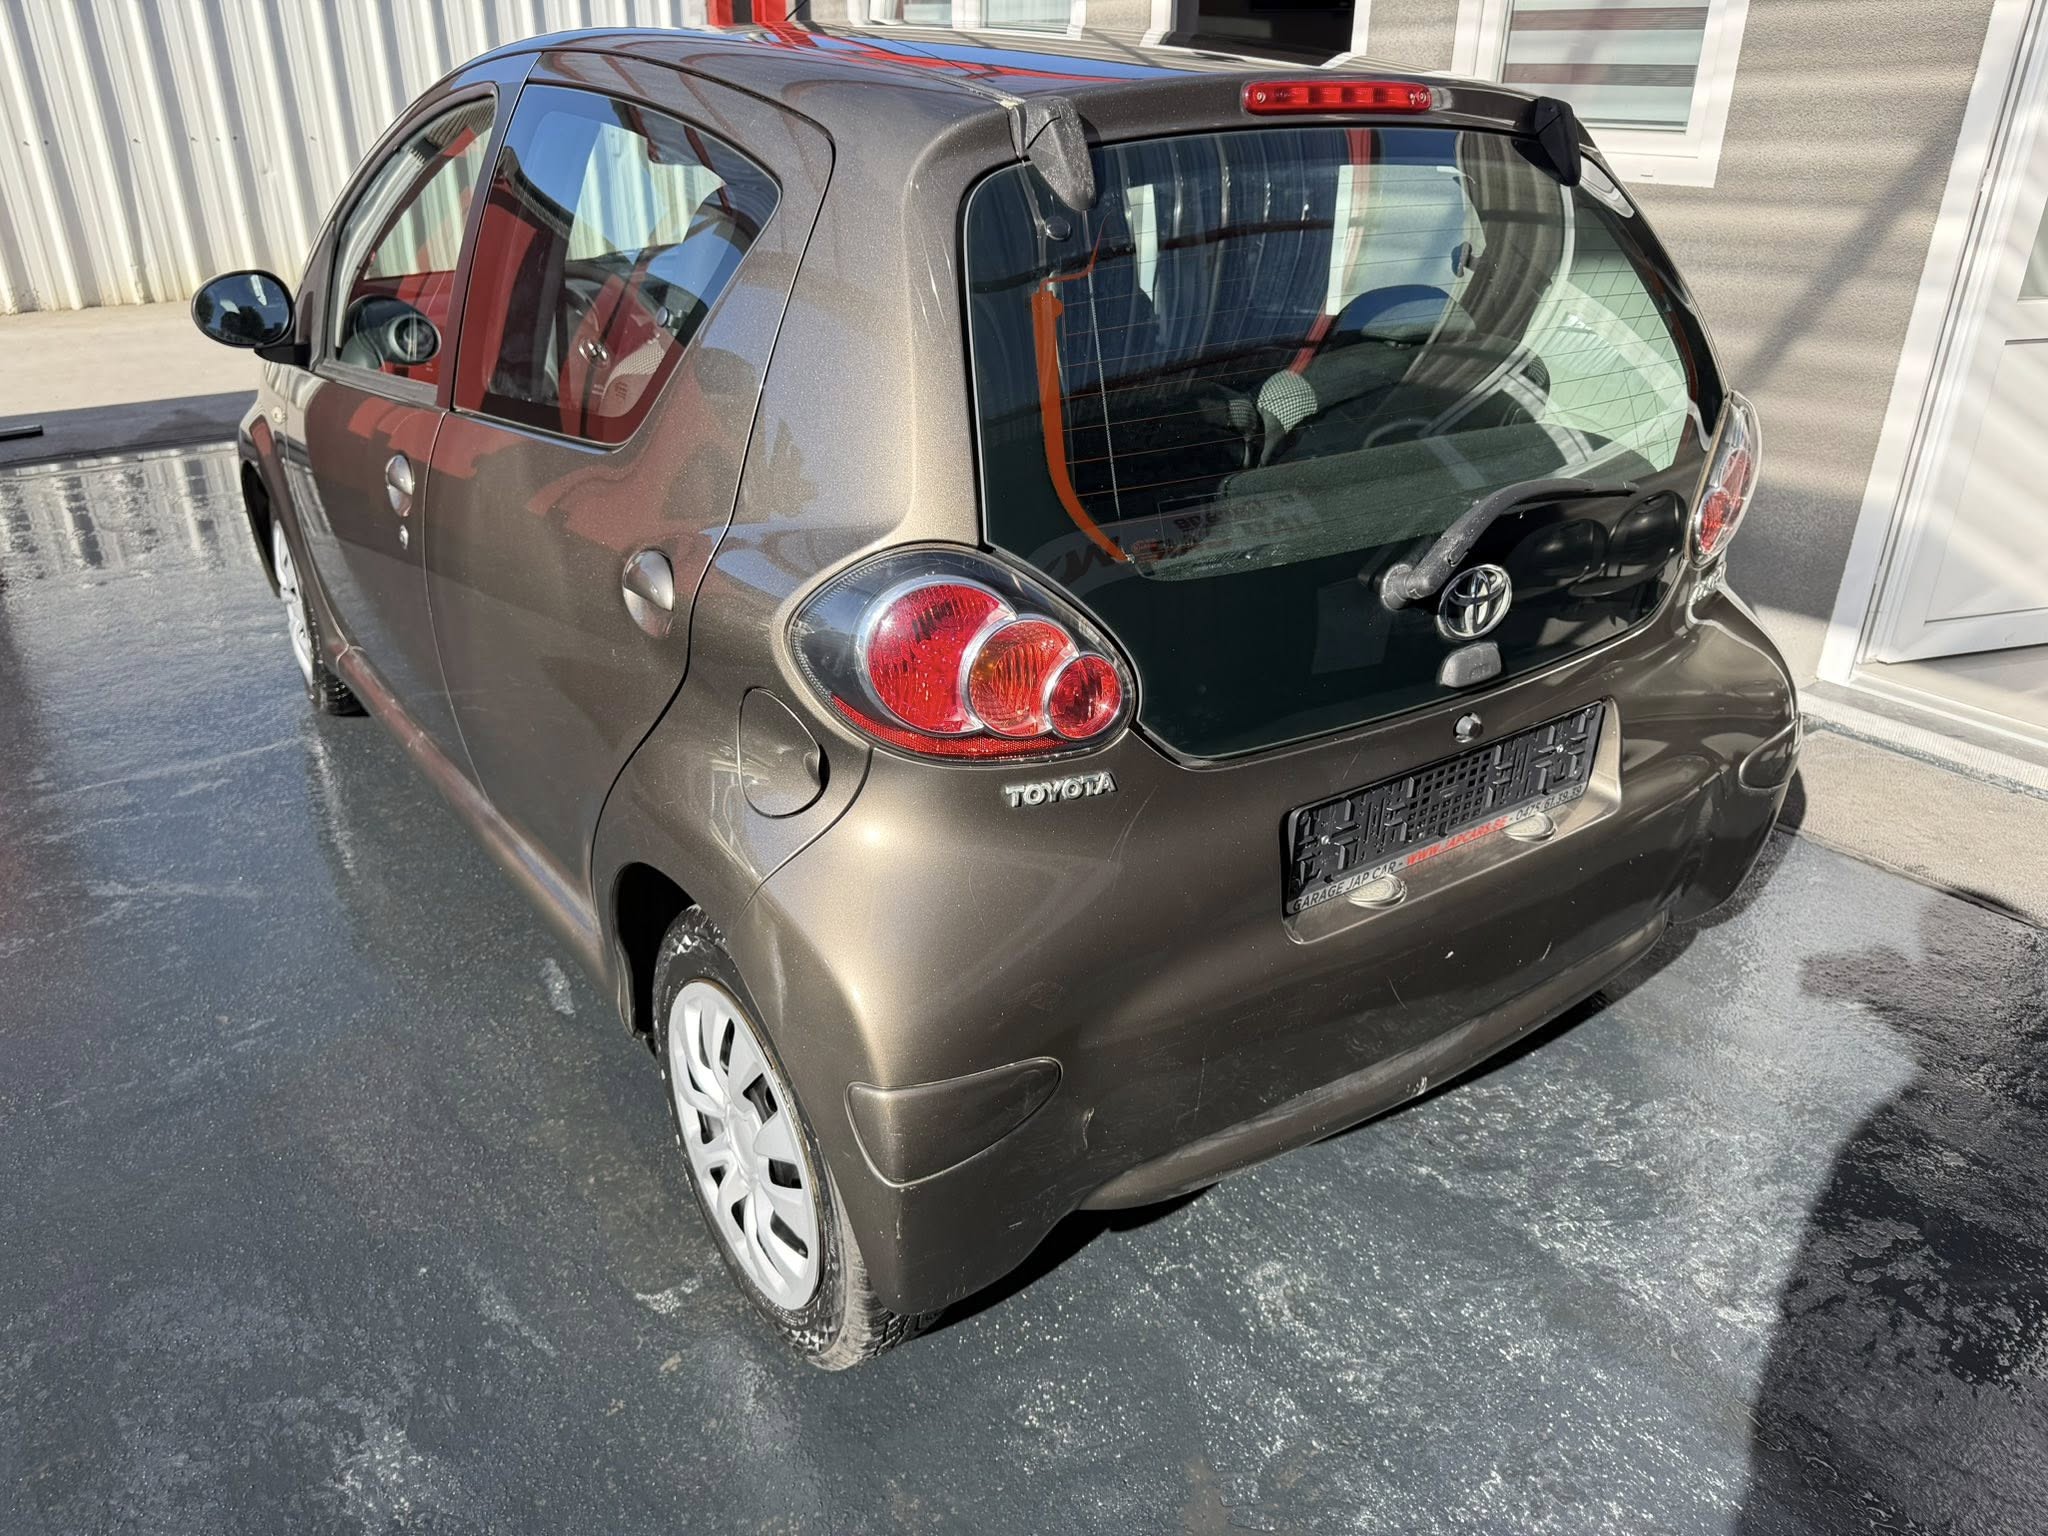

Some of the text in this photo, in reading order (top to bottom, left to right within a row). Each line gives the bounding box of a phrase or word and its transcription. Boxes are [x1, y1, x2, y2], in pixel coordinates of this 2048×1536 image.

[1006, 771, 1118, 807] TOYOTA
[1293, 882, 1344, 911] GARAGE
[1346, 872, 1369, 890] JAP
[1372, 861, 1397, 880] CAR
